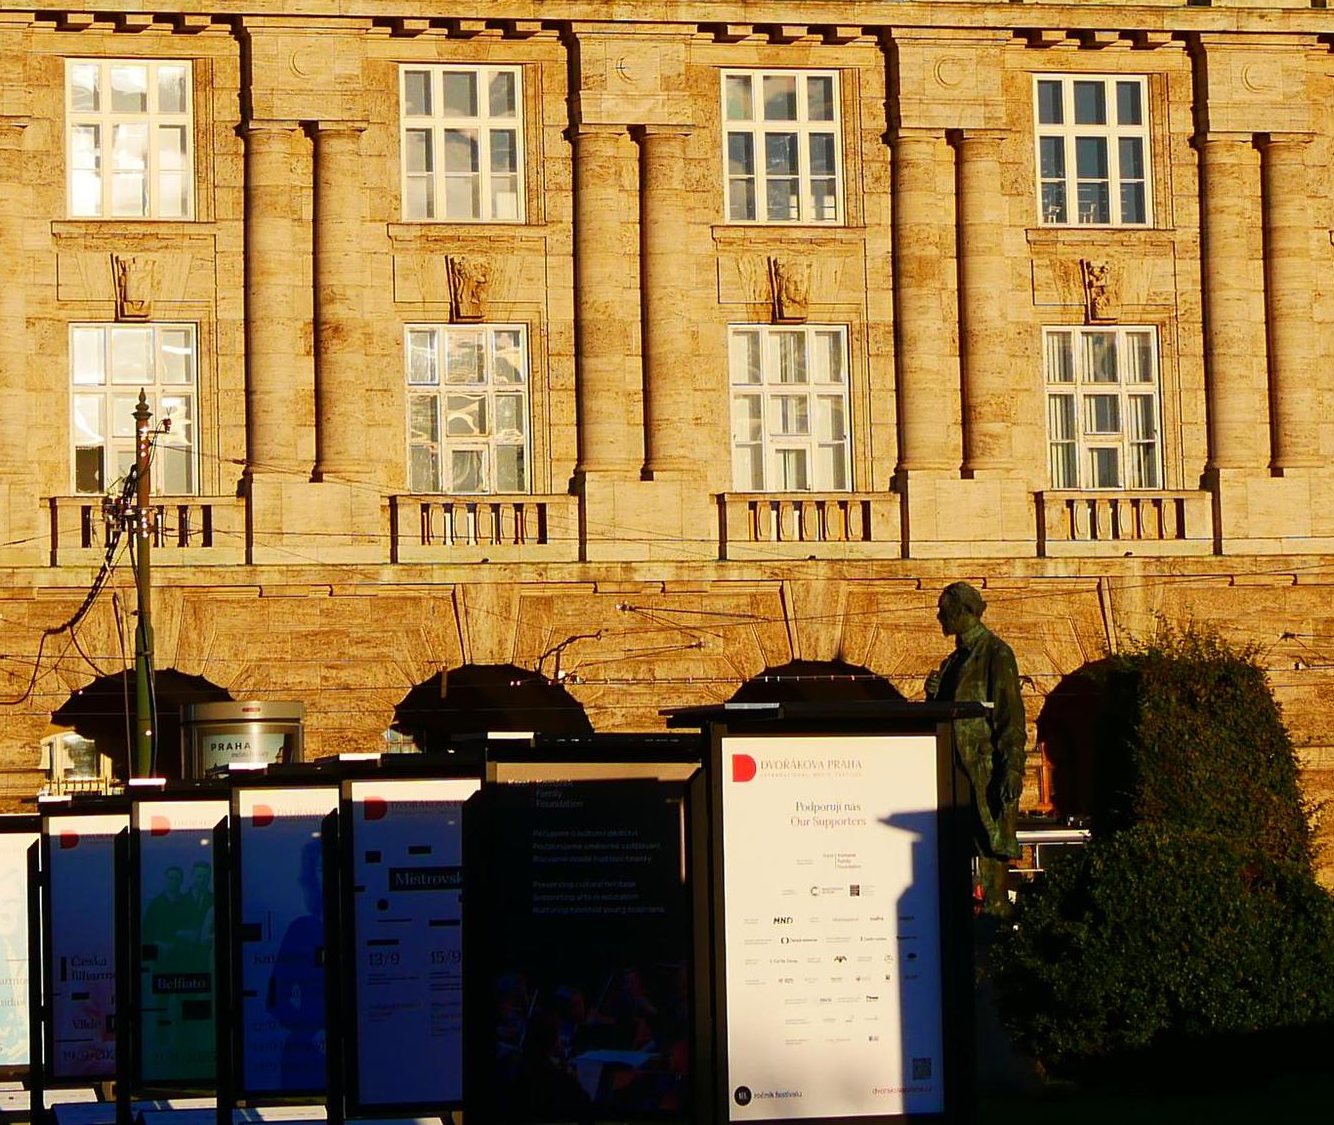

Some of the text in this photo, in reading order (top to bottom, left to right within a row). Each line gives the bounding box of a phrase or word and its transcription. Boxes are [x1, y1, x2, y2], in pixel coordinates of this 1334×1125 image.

[210, 742, 250, 751] PRAHA
[827, 760, 862, 769] PRAHA
[790, 816, 867, 828] Our Supporters
[773, 916, 794, 925] MND
[369, 951, 400, 967] 13/9
[157, 978, 206, 989] Belfiato
